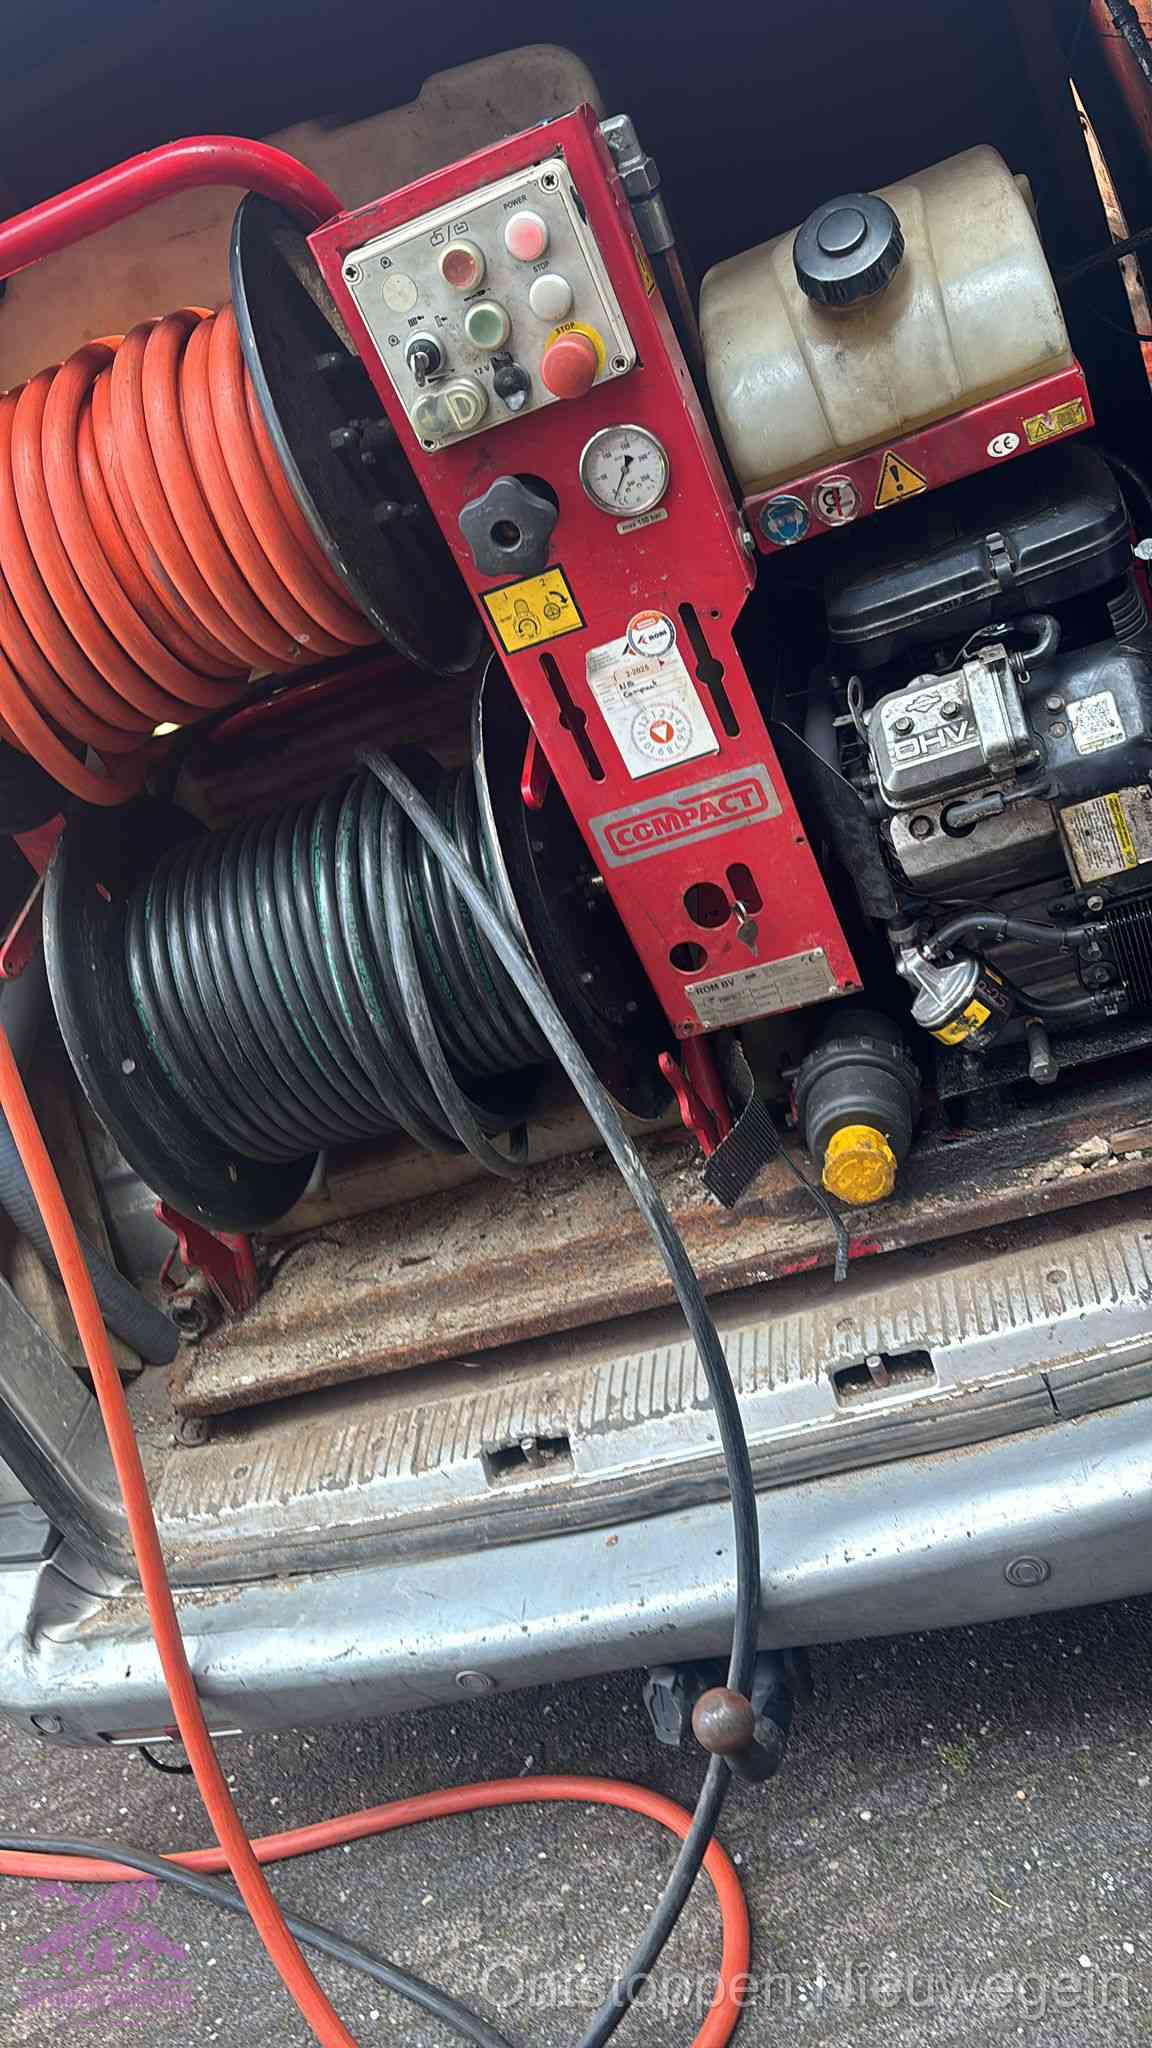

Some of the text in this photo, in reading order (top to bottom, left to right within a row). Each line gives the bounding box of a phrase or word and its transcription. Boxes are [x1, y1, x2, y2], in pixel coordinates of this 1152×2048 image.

[503, 194, 528, 210] POWER
[533, 260, 550, 273] STOP
[555, 321, 576, 335] STOP
[993, 435, 1015, 455] CE
[895, 720, 969, 761] OHV
[616, 787, 755, 847] COMPACT
[696, 979, 736, 996] ROM BV
